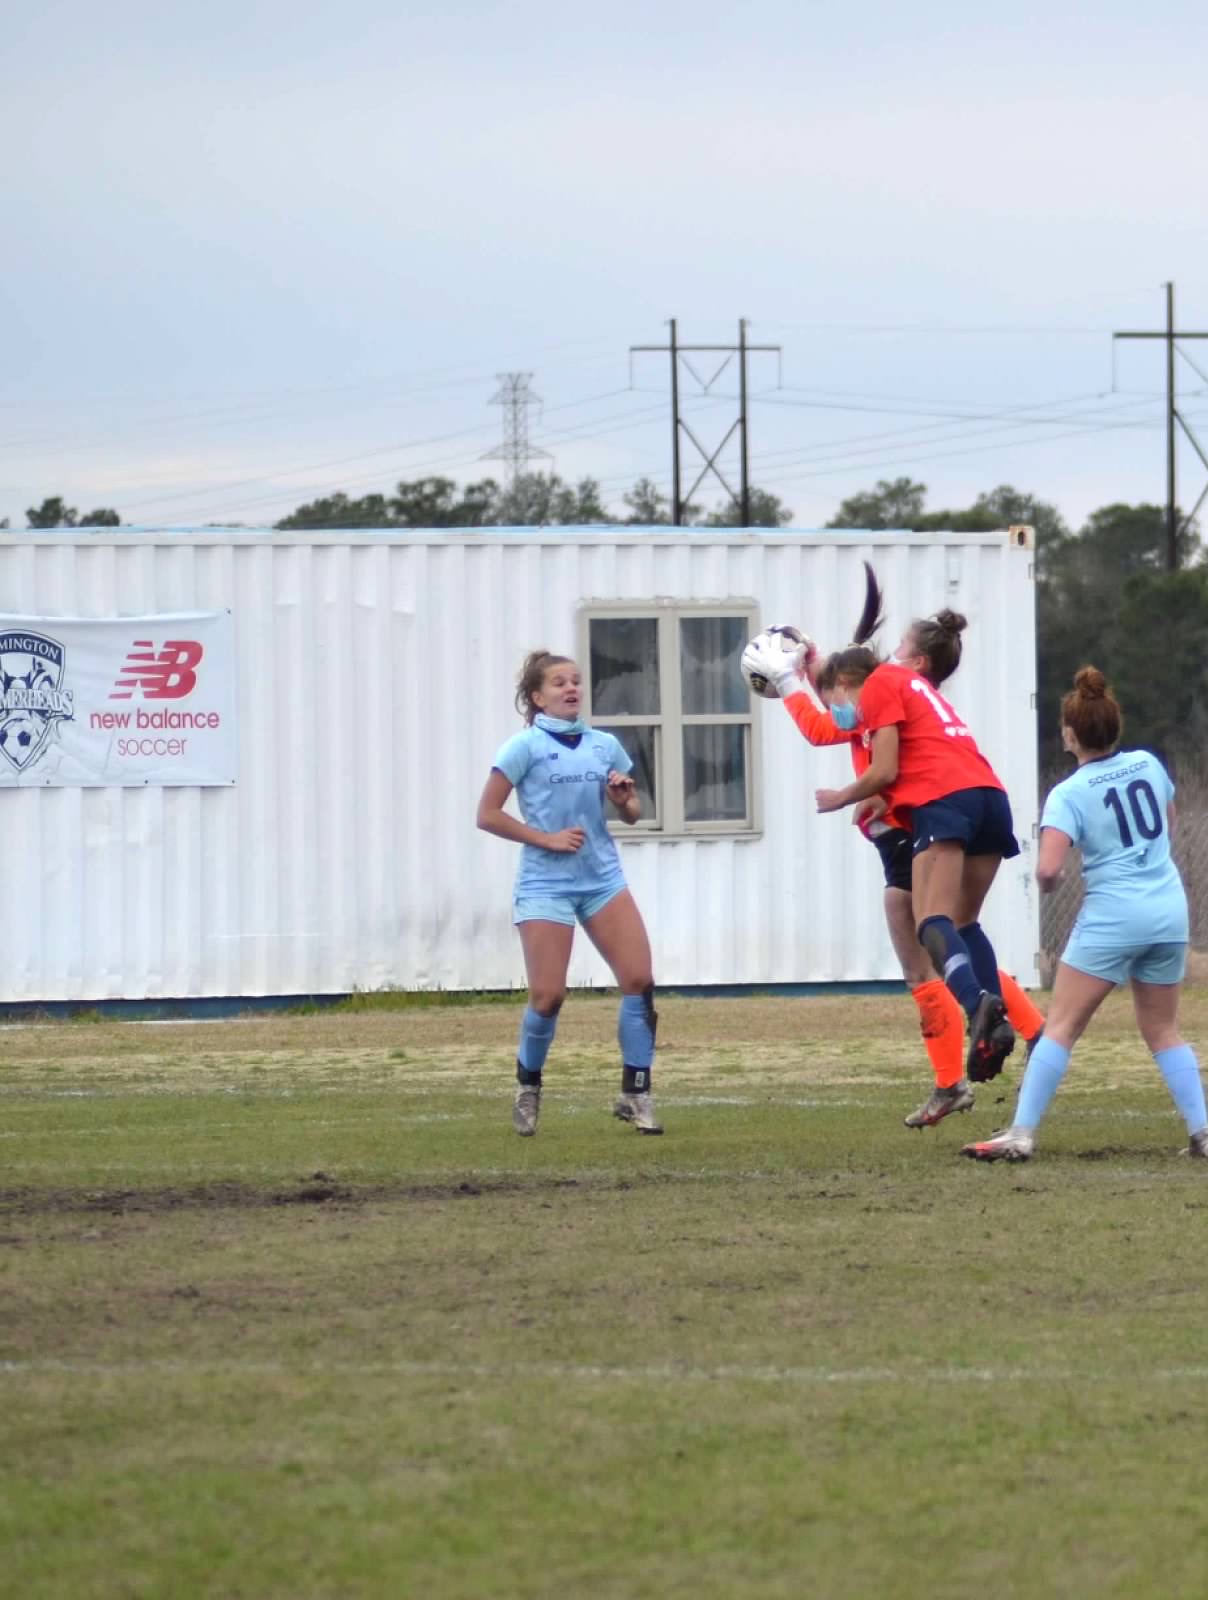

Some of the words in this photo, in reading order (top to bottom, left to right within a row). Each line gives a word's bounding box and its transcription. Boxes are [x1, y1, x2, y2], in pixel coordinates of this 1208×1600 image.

[90, 711, 131, 729] new
[136, 707, 220, 729] balance
[118, 739, 187, 756] soccer
[549, 773, 583, 784] Great
[1103, 779, 1163, 848] 10
